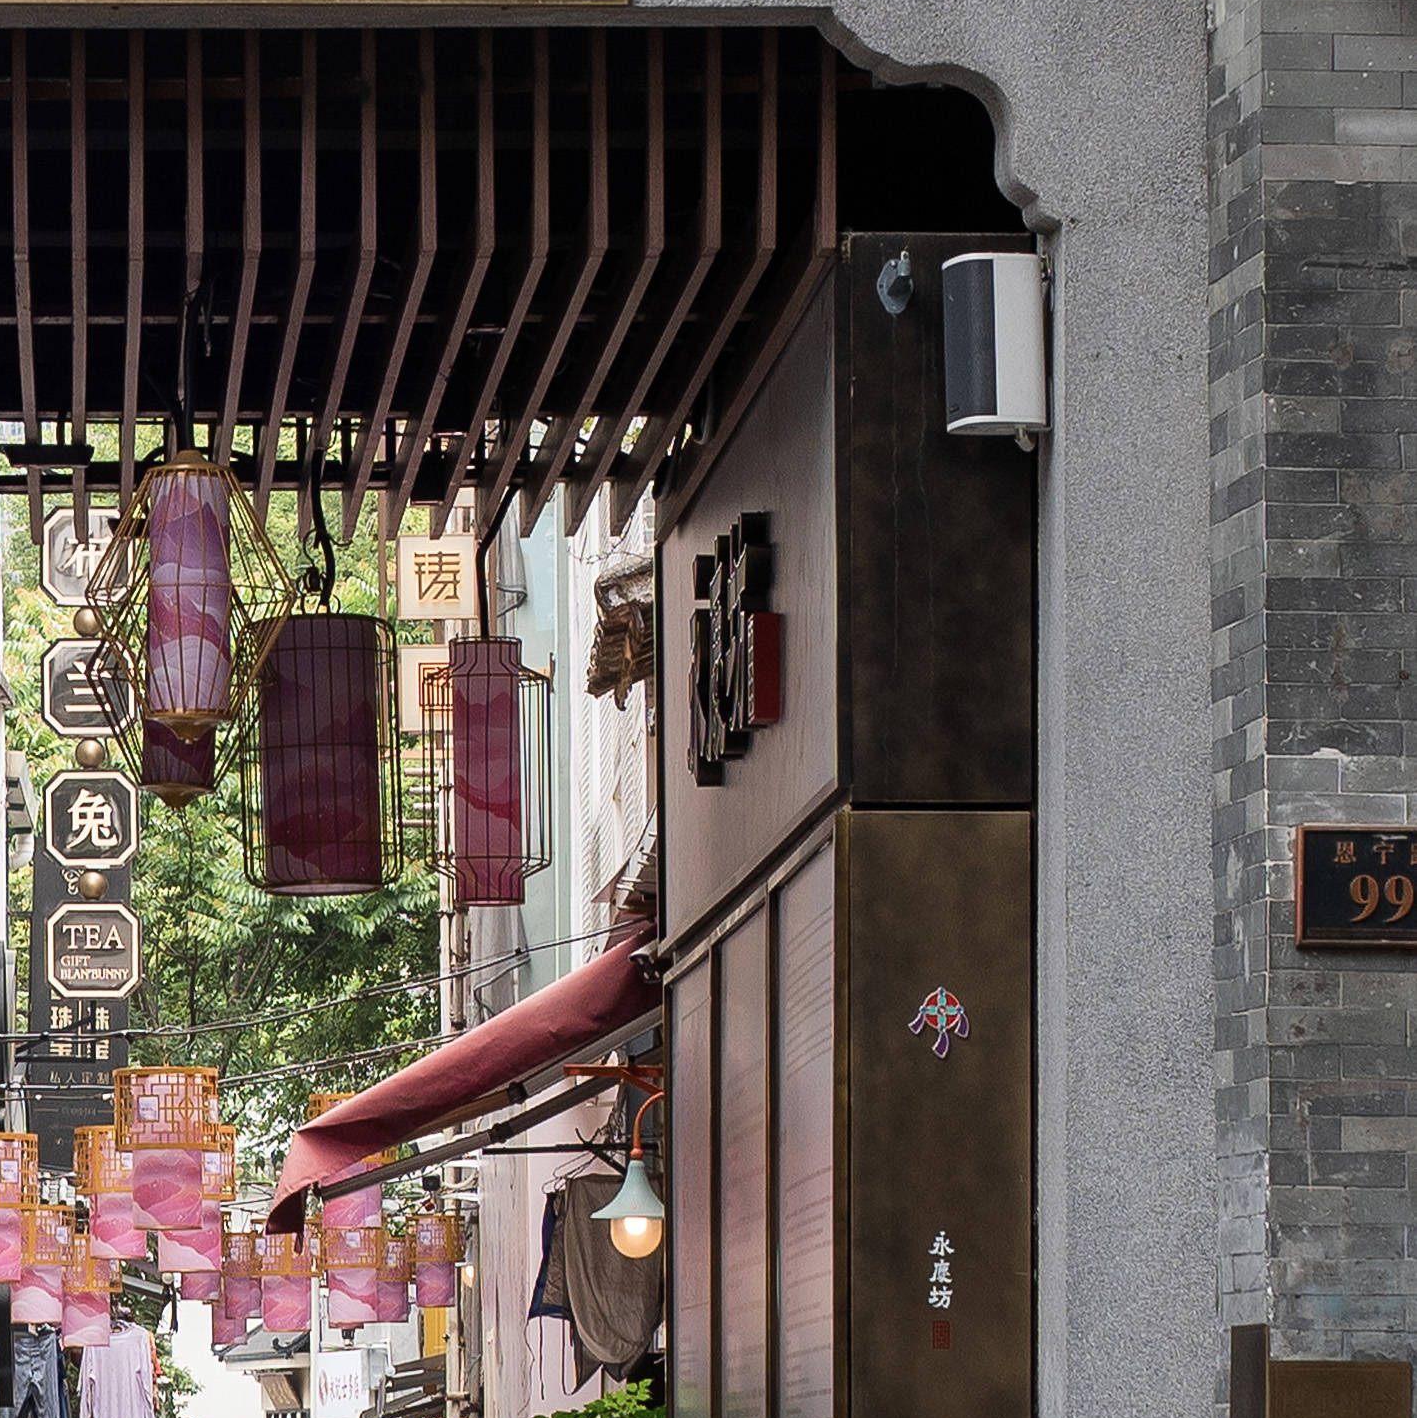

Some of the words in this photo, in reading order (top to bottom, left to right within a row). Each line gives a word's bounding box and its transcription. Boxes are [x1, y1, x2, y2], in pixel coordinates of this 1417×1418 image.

[1350, 874, 1414, 922] 99
[62, 924, 126, 950] TEA
[60, 955, 91, 968] GIFT
